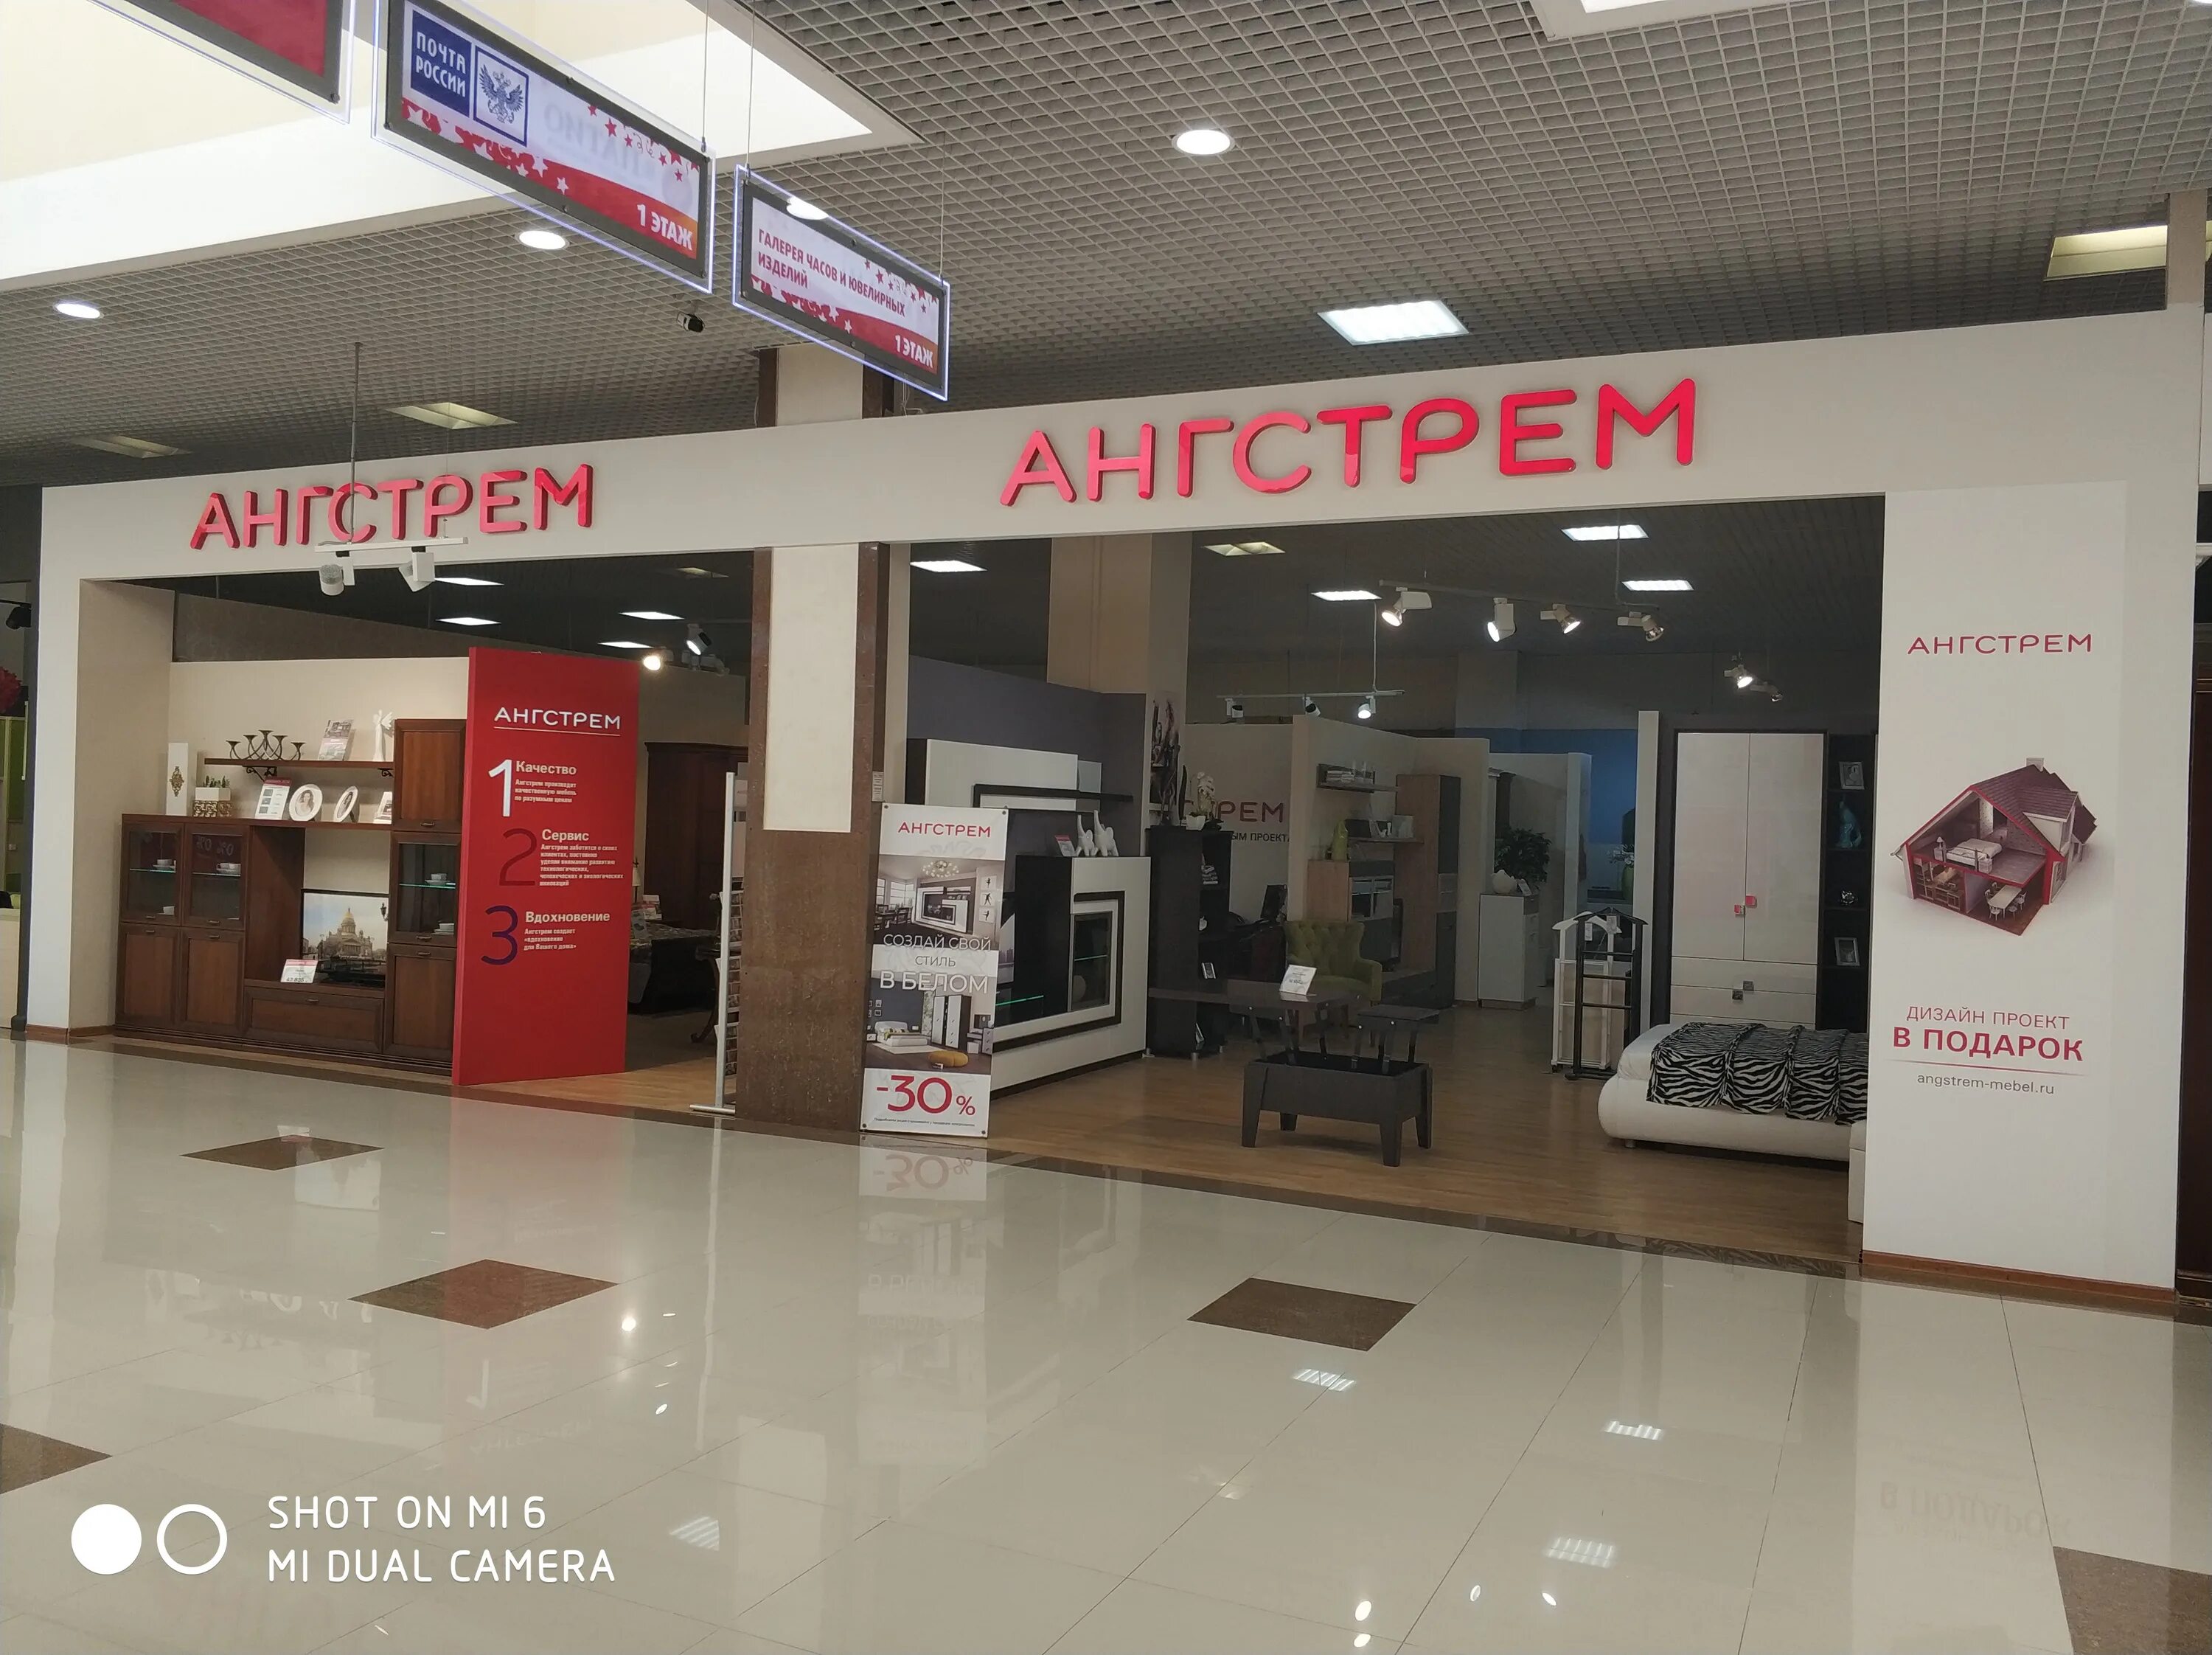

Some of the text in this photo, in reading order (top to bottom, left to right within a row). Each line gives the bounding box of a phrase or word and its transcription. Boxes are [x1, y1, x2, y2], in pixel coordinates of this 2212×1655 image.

[417, 31, 466, 74] ПОЧТА
[416, 55, 466, 97] РОССИИ
[636, 204, 693, 251] 1 ЭТАЖ
[758, 251, 808, 288] ИЗДЕЛИЙ
[759, 229, 905, 317] ГАЛЕРЕЯ ЧАСОВ И ЮВЕЛИРНЫХ
[895, 335, 933, 368] 1 ЭТАЖ
[1000, 378, 1696, 507] АНГСТРЕМ
[190, 463, 593, 549] АНГСТРЕМ
[1907, 633, 2092, 655] АНГСТРЕМ
[494, 707, 621, 729] АНГСТРЕМ
[488, 759, 577, 817] 1 Качество
[1211, 800, 1284, 822] РЕМ
[898, 822, 991, 838] АНГСТРЕМ
[1251, 833, 1290, 842] ПРОЕКТ
[499, 828, 589, 886] 2 Сервис
[481, 905, 611, 965] 3 Вдохновение
[883, 933, 991, 951] СОЗДАЙ СВОЙ
[915, 956, 956, 967] СТИЛЬ
[880, 971, 989, 994] В БЕЛОМ
[1906, 1006, 2070, 1030] ДИЗАЙН ПРОЕКТ
[1893, 1026, 2083, 1061] В ПОДАРОК
[1917, 1075, 2054, 1094] angstrem-mebel.ru
